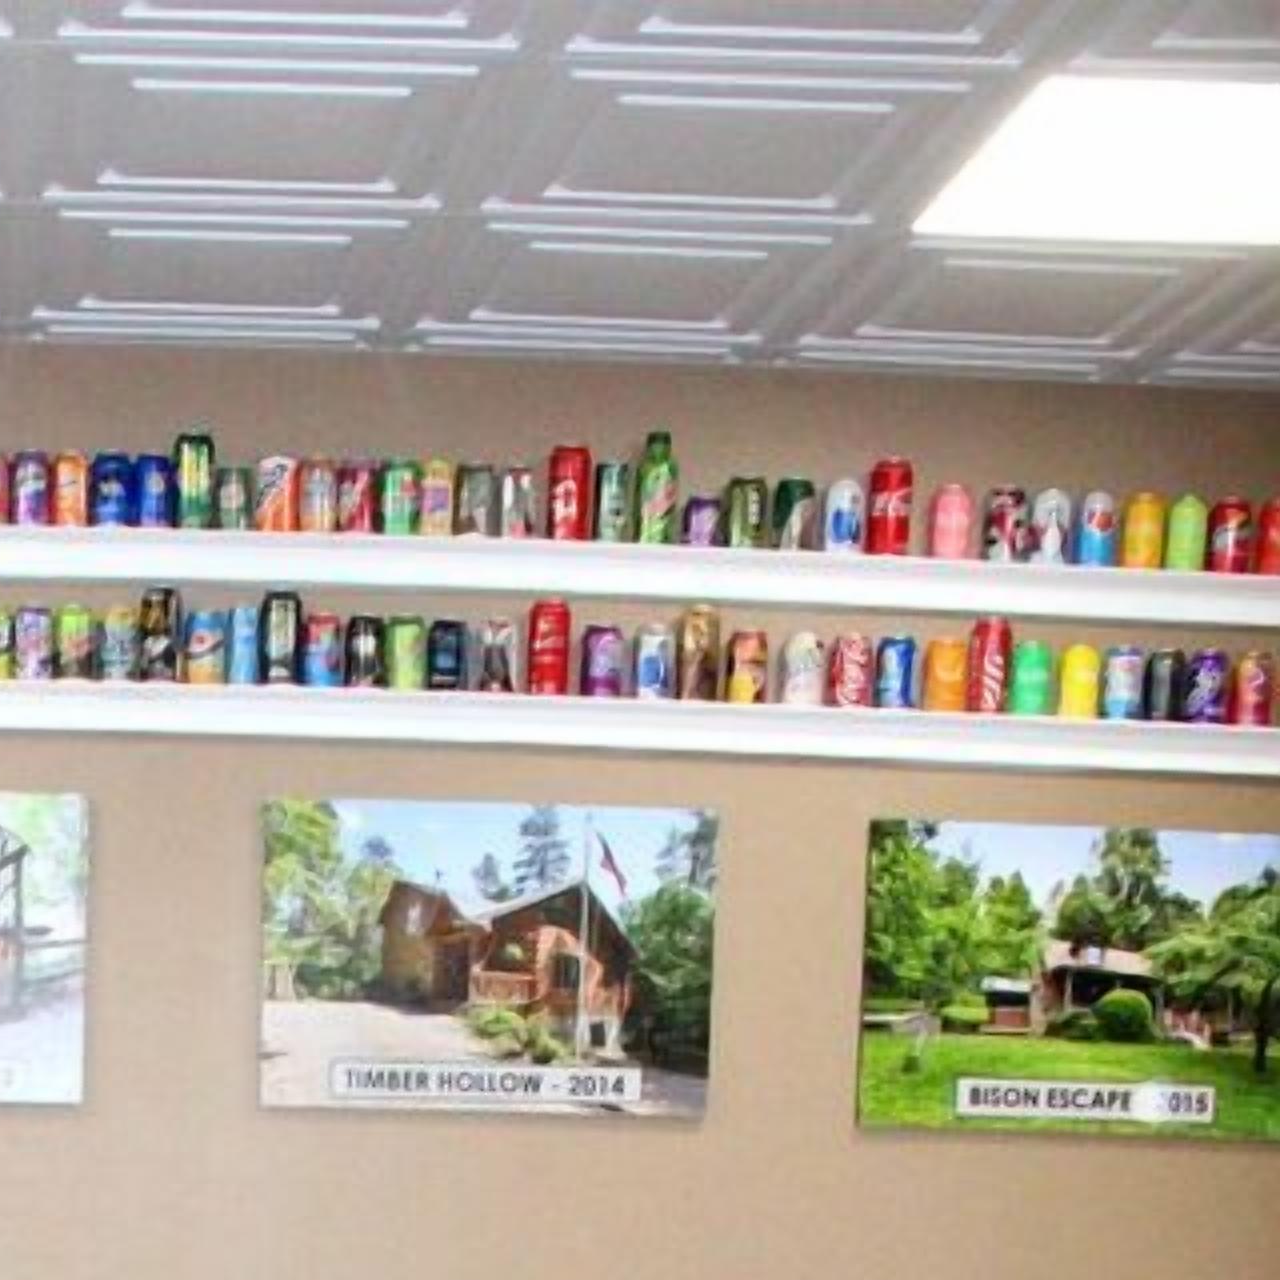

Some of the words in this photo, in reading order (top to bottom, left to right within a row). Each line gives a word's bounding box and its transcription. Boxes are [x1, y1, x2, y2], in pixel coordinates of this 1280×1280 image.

[345, 1067, 430, 1090] TIMBER
[437, 1070, 542, 1094] HOLLOW
[569, 1074, 625, 1096] 2014
[969, 1086, 1039, 1108] BISON
[1047, 1087, 1132, 1111] ESCAPE
[1158, 1090, 1210, 1115] 015
